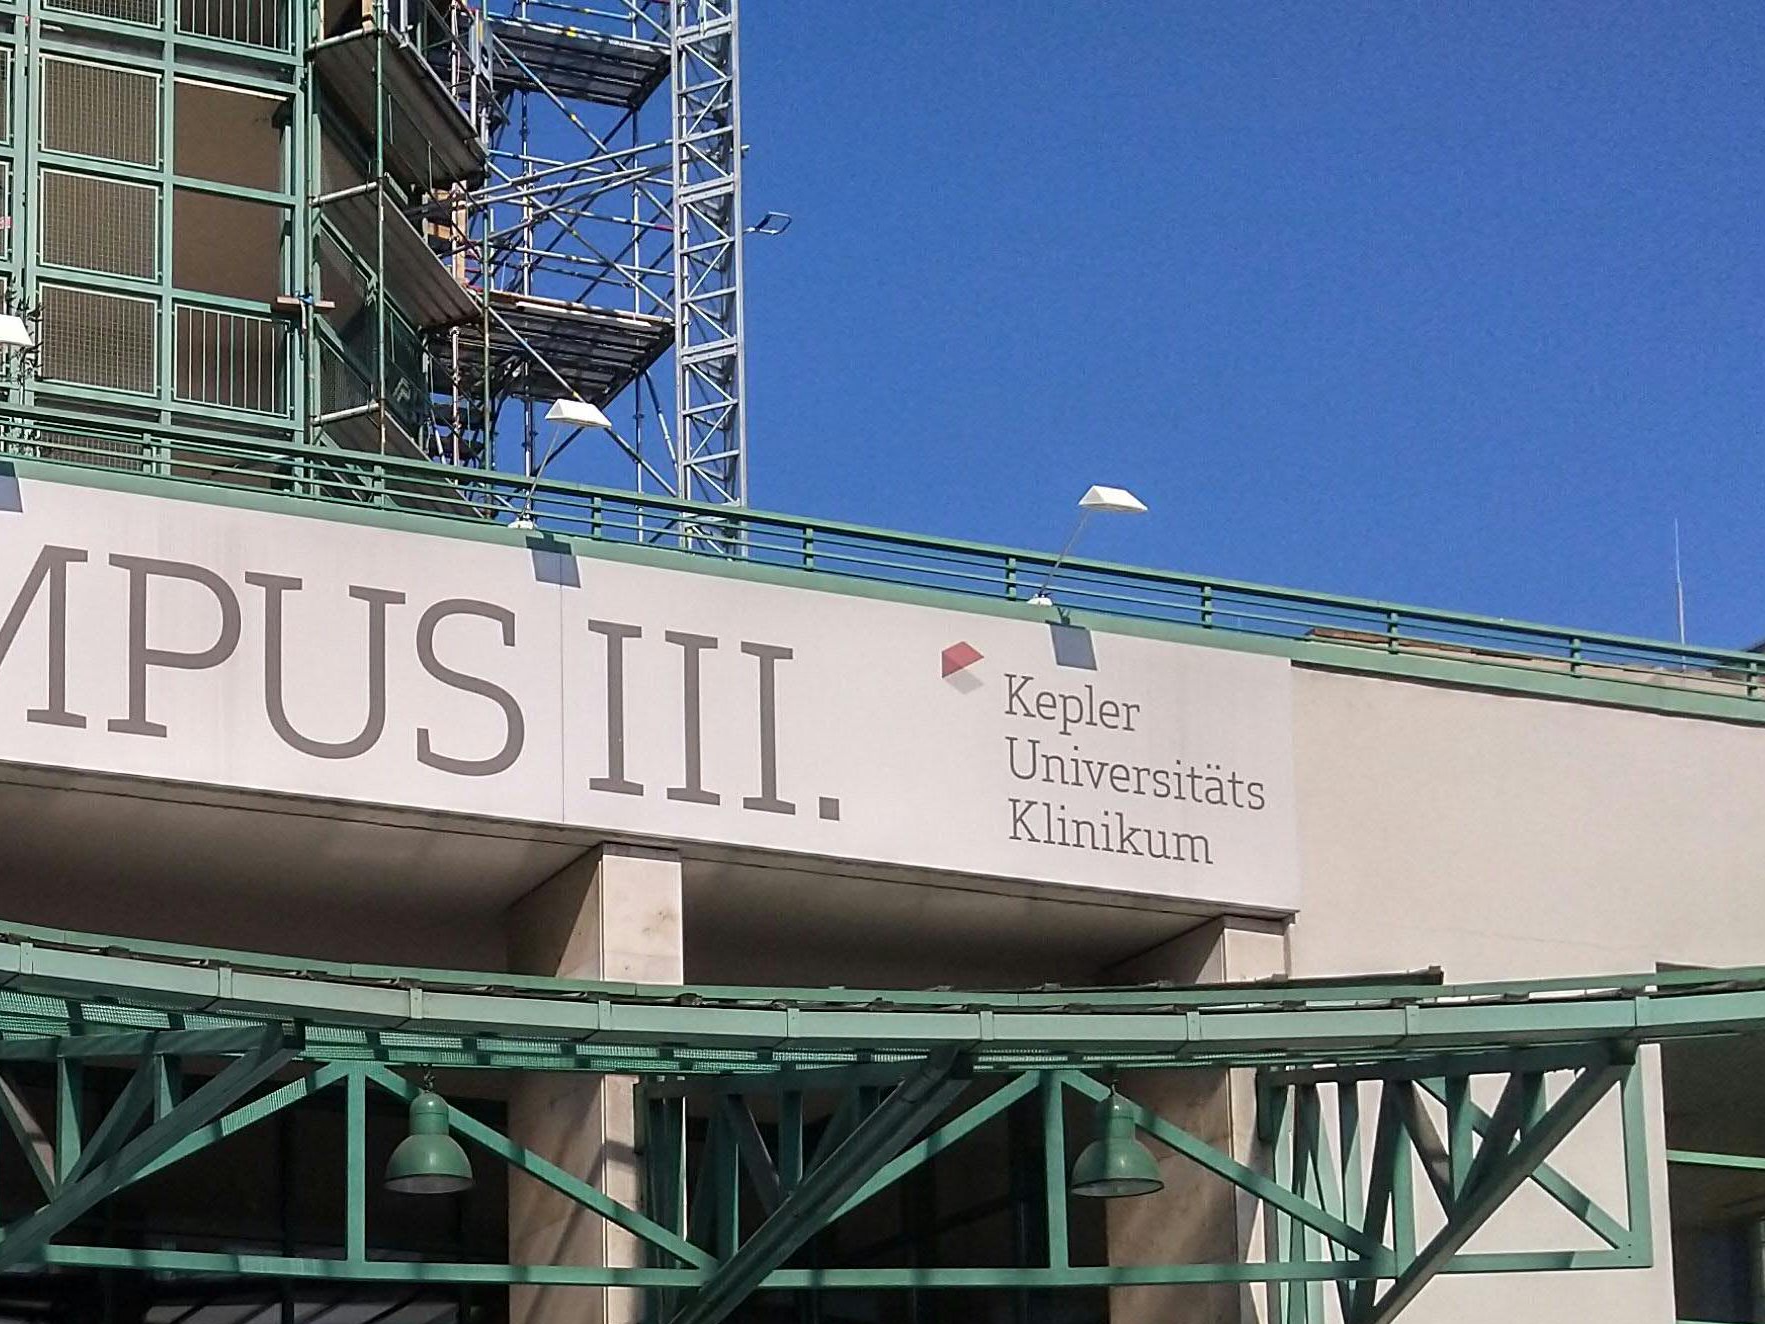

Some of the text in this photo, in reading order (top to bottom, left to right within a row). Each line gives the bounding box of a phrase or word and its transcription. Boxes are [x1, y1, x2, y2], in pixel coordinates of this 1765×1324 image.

[588, 619, 839, 821] III.
[1004, 673, 1140, 735] Kepler
[1005, 736, 1265, 811] Universitäts
[1008, 798, 1214, 865] Klinikum
